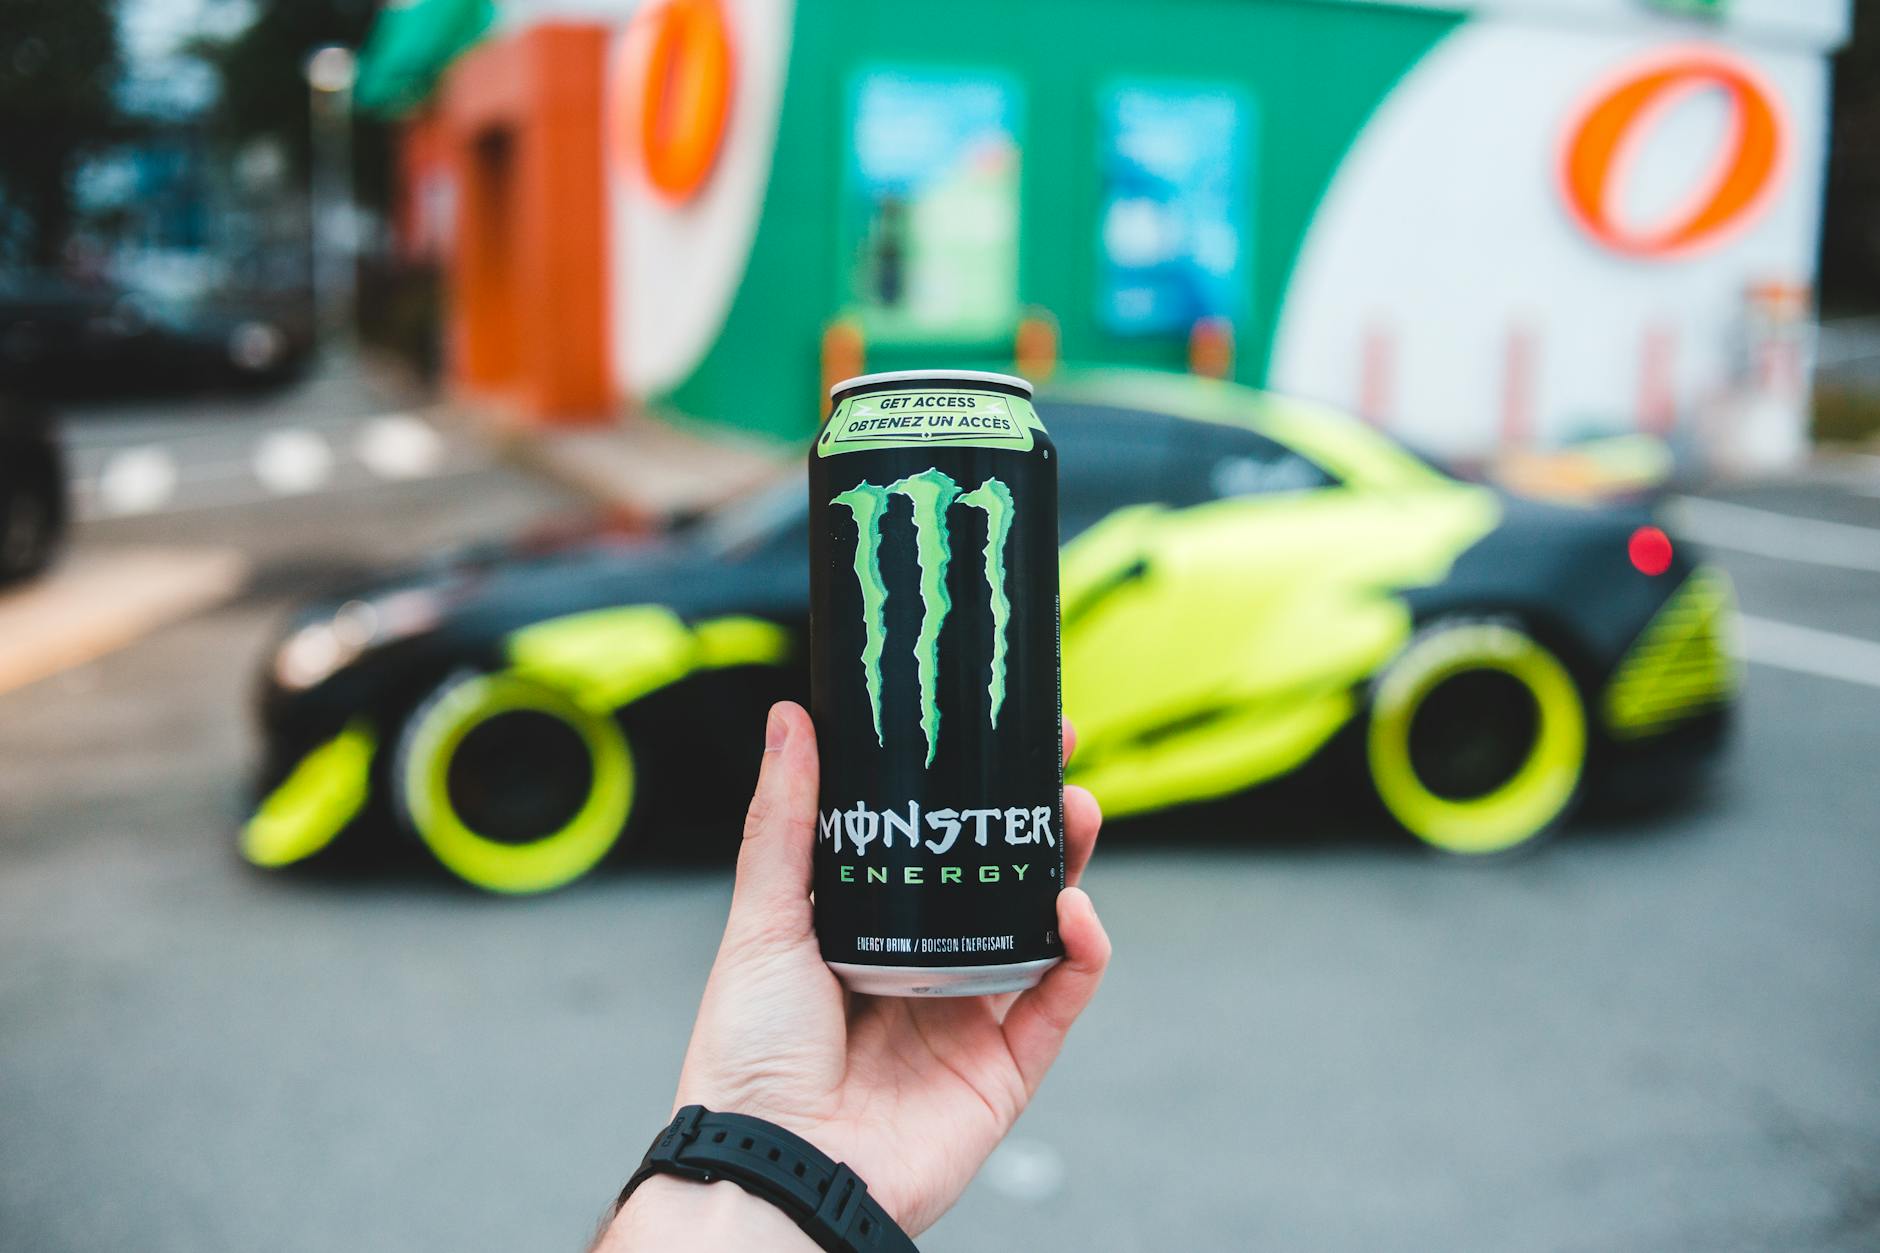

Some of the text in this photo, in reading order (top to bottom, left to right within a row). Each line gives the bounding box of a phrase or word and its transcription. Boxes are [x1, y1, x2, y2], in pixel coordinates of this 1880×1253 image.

[881, 396, 976, 409] GET ACCESS
[848, 415, 1011, 432] OBTENEZ UN ACCÈS
[819, 800, 1056, 856] MONSTER
[840, 863, 1030, 884] ENERGY
[857, 936, 885, 951] ENERGY
[886, 937, 912, 953] DRINK
[921, 938, 959, 953] BOISSON
[961, 935, 1014, 952] ÉNERGISANTE
